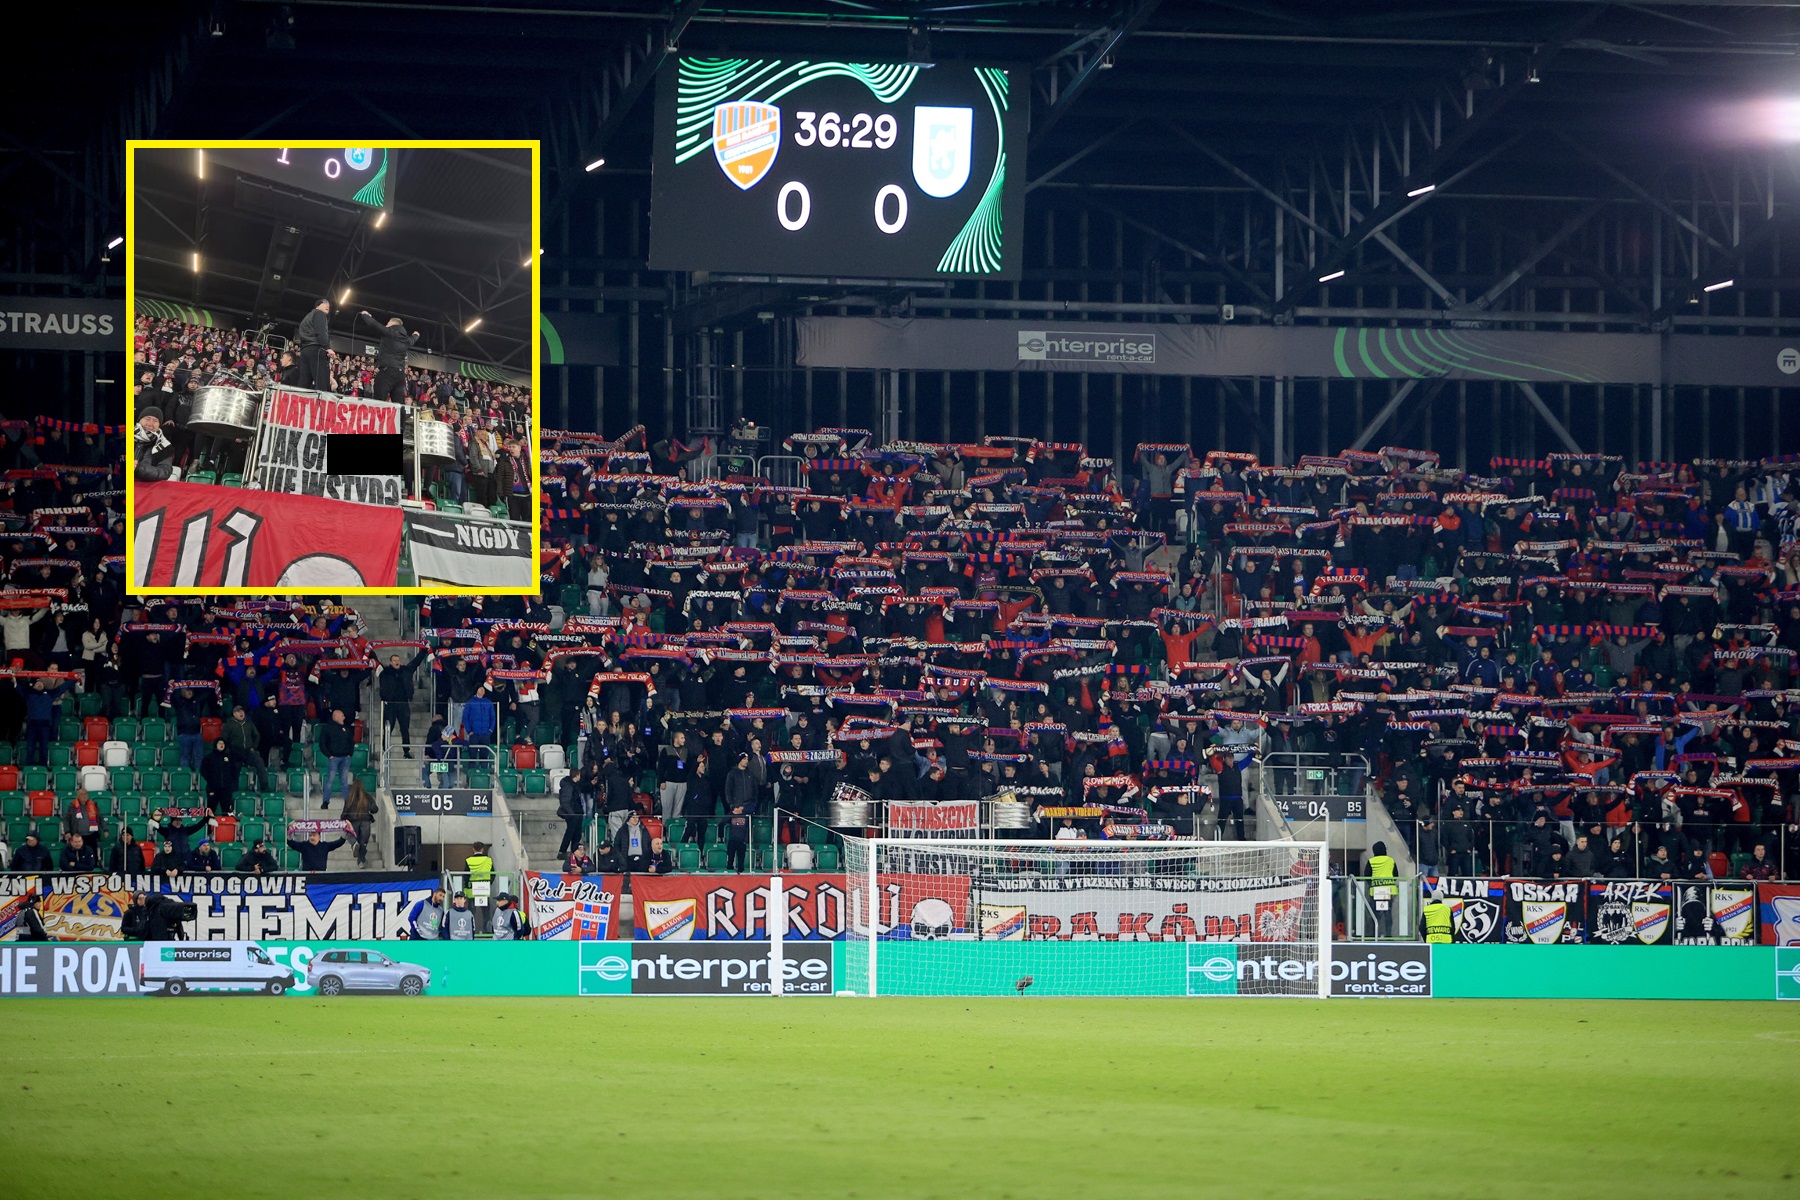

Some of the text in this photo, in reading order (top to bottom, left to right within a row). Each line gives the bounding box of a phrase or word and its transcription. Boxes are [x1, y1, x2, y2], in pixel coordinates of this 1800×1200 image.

[794, 111, 897, 149] 36:29
[324, 158, 341, 178] 0
[777, 181, 811, 231] 0
[874, 184, 908, 234] 0
[1026, 338, 1153, 358] enterprise
[261, 426, 300, 464] JAK
[454, 524, 520, 550] NIGDY
[396, 794, 411, 805] B3
[431, 794, 453, 811] 05
[473, 795, 488, 805] B4
[1308, 801, 1329, 817] 06
[1347, 801, 1362, 812] B5
[35, 877, 43, 895] I
[51, 872, 162, 895] WSPÓLNI
[169, 876, 307, 895] WROGOWIE
[529, 877, 614, 903] Red-Blue
[998, 879, 1035, 890] NIGDY
[1040, 879, 1059, 889] NIE
[1156, 879, 1196, 890] SWEGO
[1200, 876, 1281, 890] POCHODZENIA
[1436, 877, 1489, 897] ALAN
[1510, 882, 1579, 903] OSKAR
[1599, 881, 1663, 904] ARTEK
[1714, 893, 1733, 901] RKS
[574, 912, 609, 921] VIDEOTON
[649, 907, 670, 915] RKS
[1526, 905, 1543, 913] RKS
[164, 949, 231, 960] enterprise
[53, 946, 146, 993] ROA
[596, 951, 828, 987] enterprise
[743, 981, 827, 992] rena-car
[1344, 981, 1426, 993] rent-a-car
